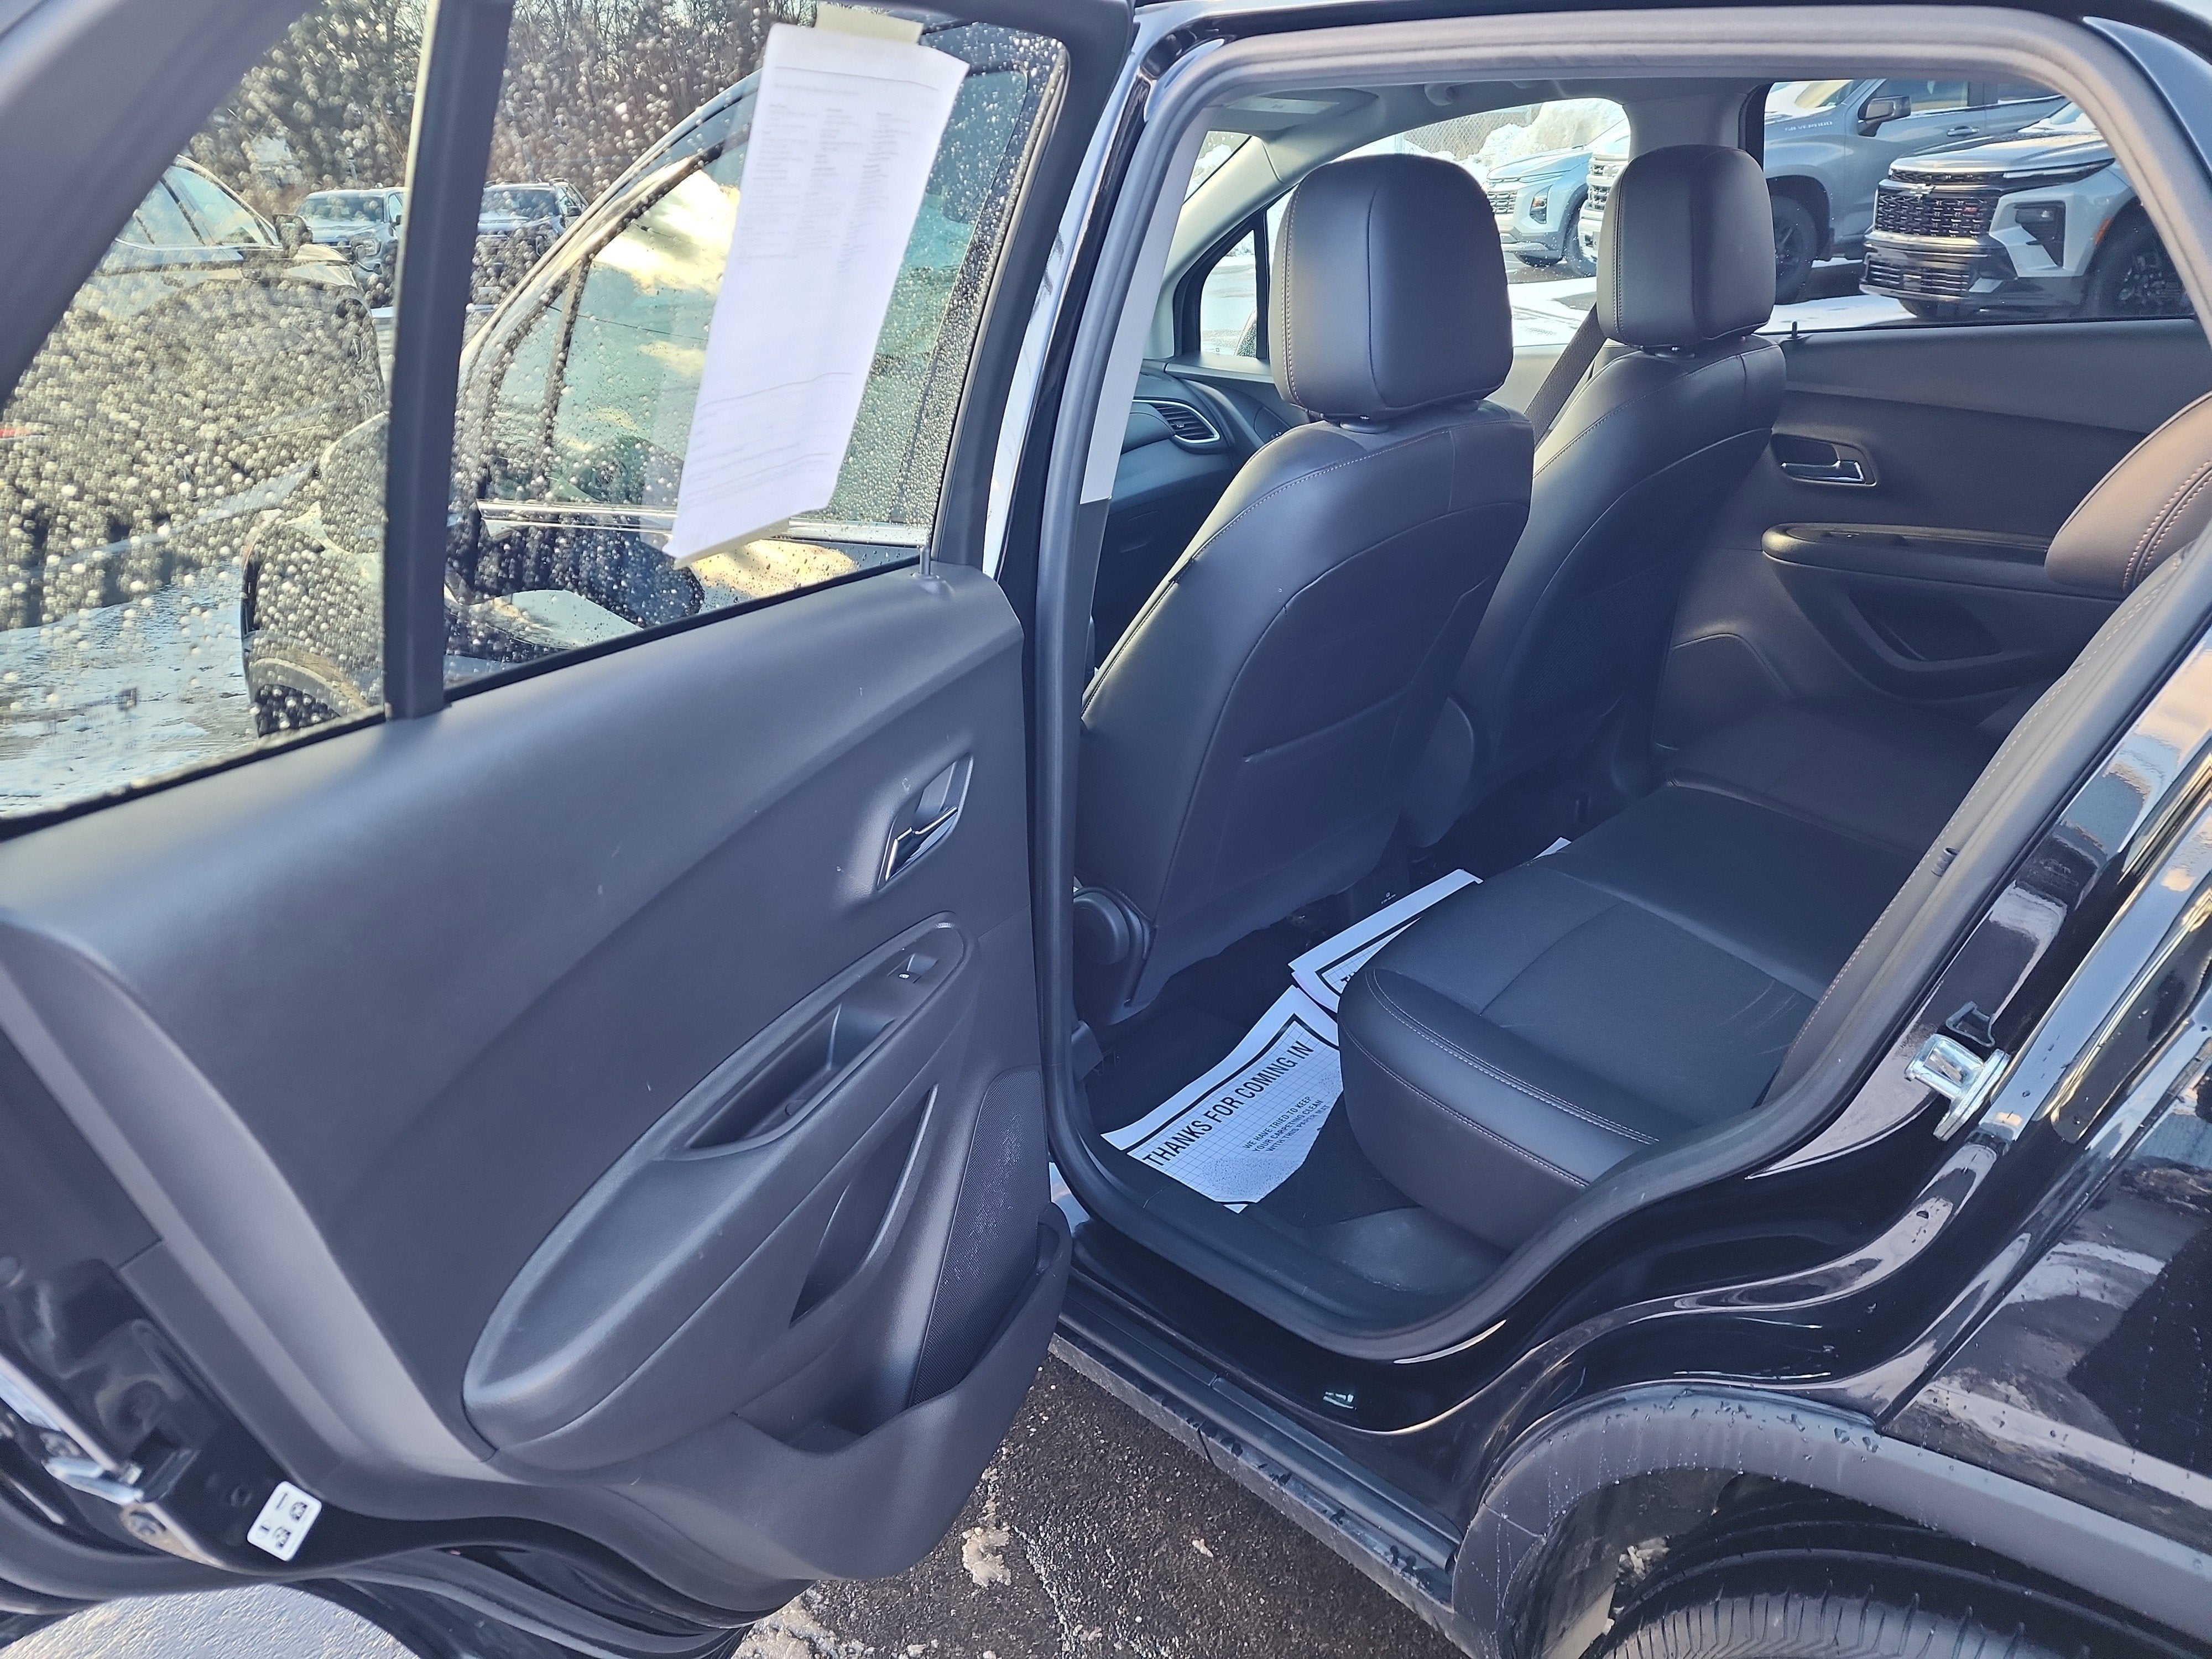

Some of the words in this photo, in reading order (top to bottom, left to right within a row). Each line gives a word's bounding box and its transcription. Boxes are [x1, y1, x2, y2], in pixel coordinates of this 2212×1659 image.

[1142, 1120, 1213, 1166] THANKS
[1203, 1097, 1245, 1123] FOR
[1234, 1057, 1298, 1099] COMING
[1286, 1040, 1314, 1060] IN
[1243, 1140, 1256, 1149] WE
[1253, 1128, 1272, 1141] HAVE
[1269, 1114, 1290, 1129] TRIED
[1295, 1096, 1311, 1109] KEEP
[1252, 1139, 1274, 1152] YOUR
[1270, 1114, 1305, 1139] CARPETING
[1302, 1099, 1324, 1115] CLEAN
[1266, 1139, 1286, 1152] WITH
